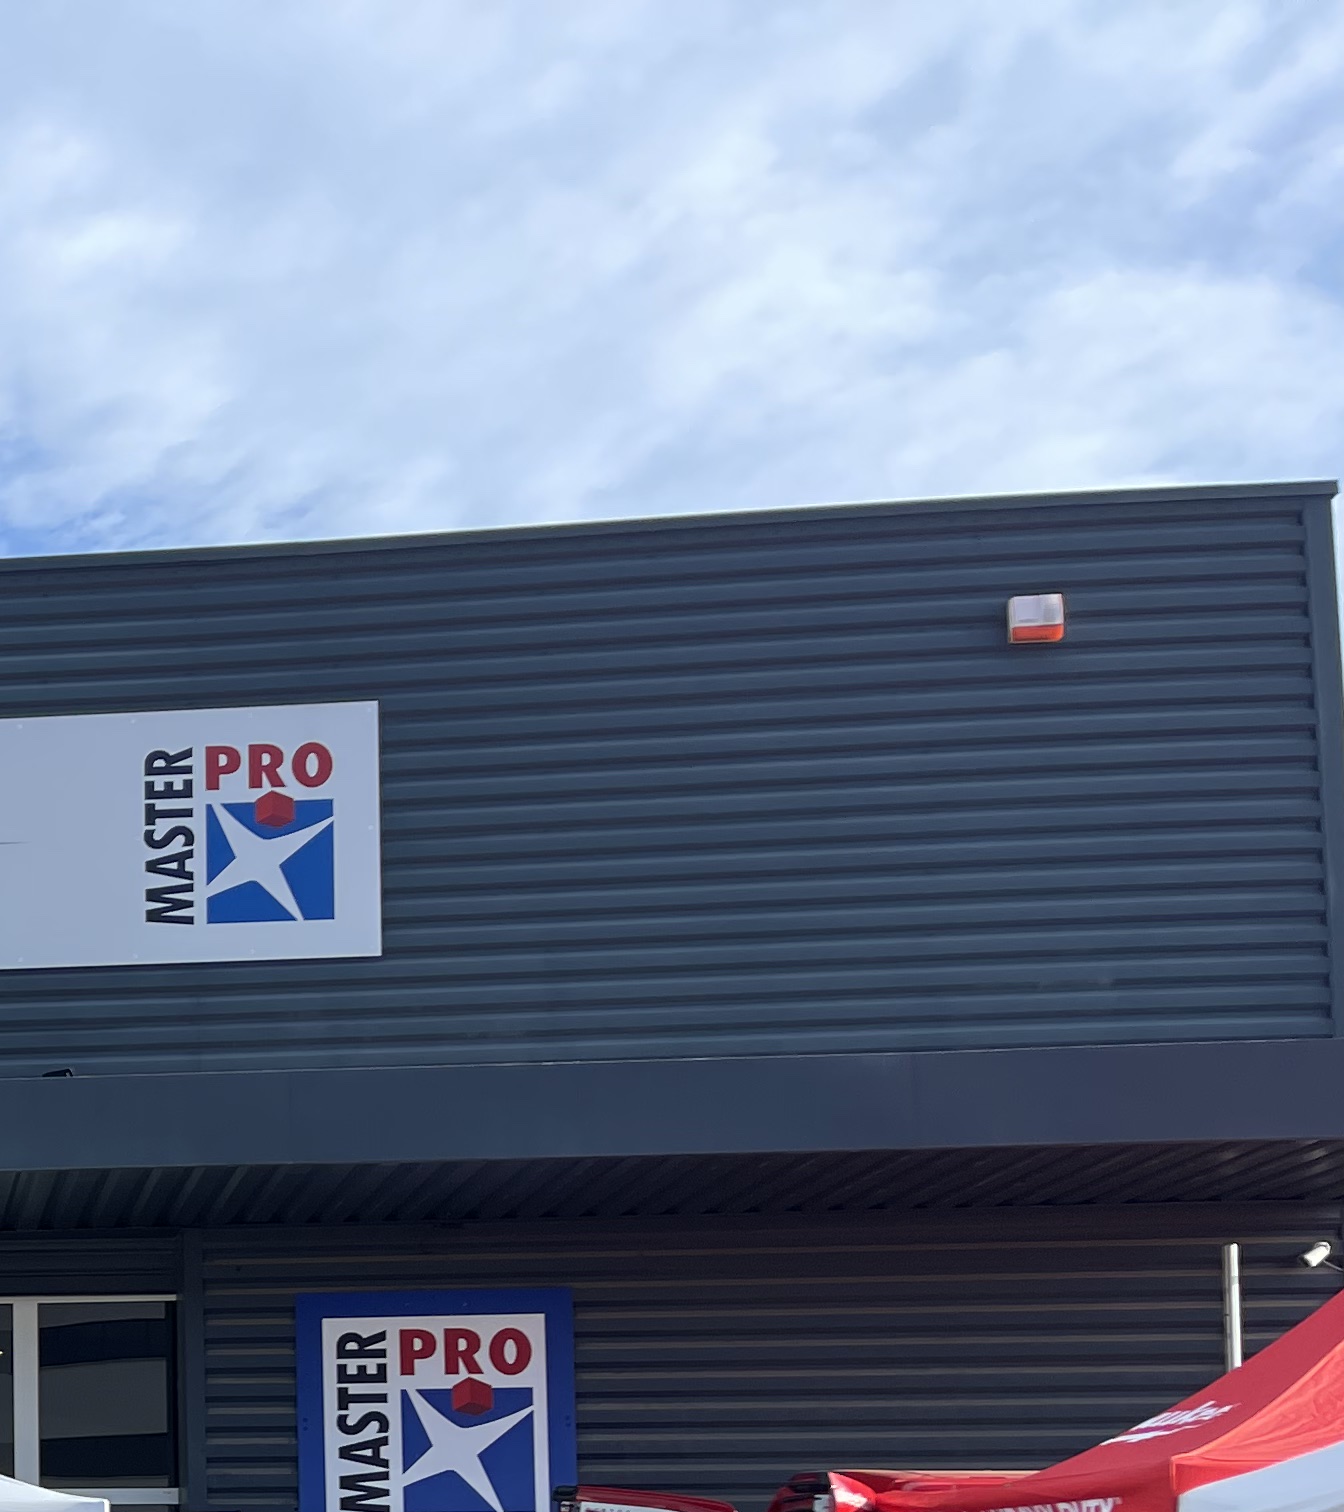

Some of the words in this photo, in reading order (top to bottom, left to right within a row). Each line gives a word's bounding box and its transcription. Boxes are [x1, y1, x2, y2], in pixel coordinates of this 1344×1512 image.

[205, 742, 333, 791] PRO
[144, 746, 195, 925] MASTER
[399, 1326, 533, 1377] PRO
